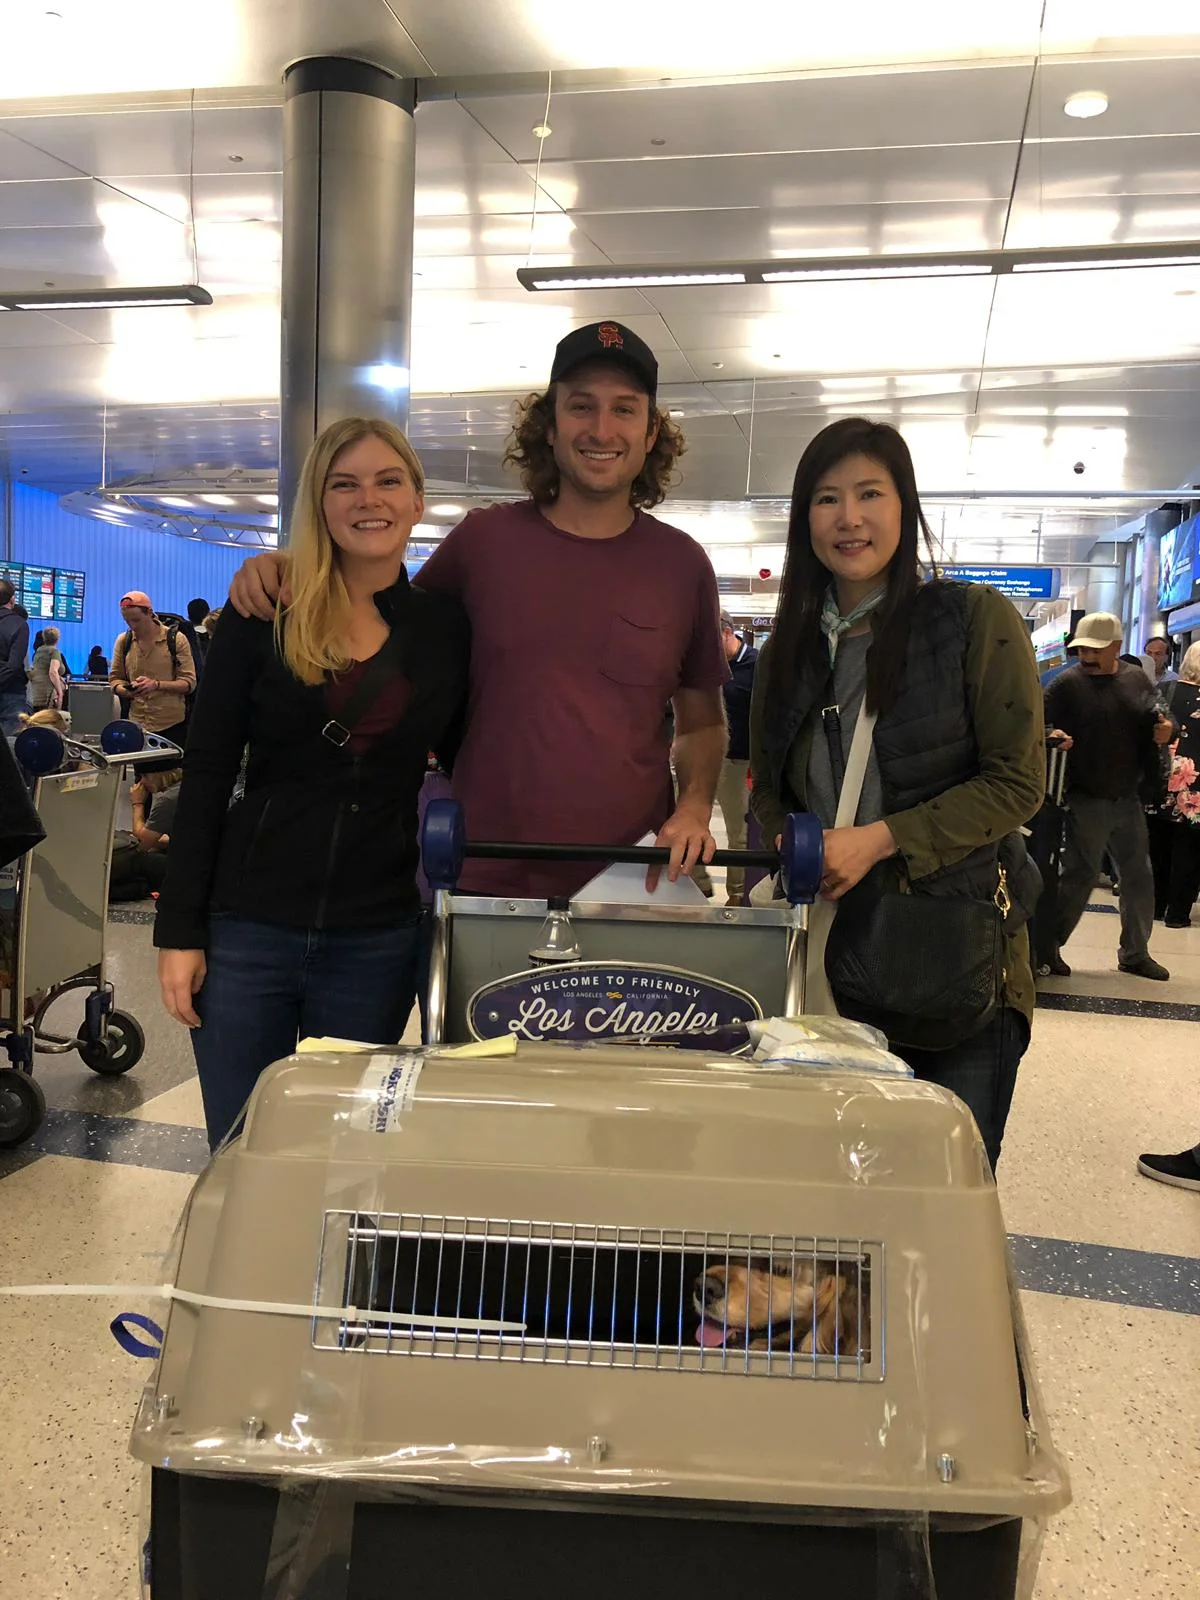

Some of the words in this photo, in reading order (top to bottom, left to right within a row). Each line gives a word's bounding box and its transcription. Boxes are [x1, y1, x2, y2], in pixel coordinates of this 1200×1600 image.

[531, 975, 600, 995] WELCOME
[606, 975, 625, 986] TO
[631, 977, 701, 999] FRIENDLY
[508, 997, 575, 1041] Los
[584, 1002, 719, 1045] Angeles
